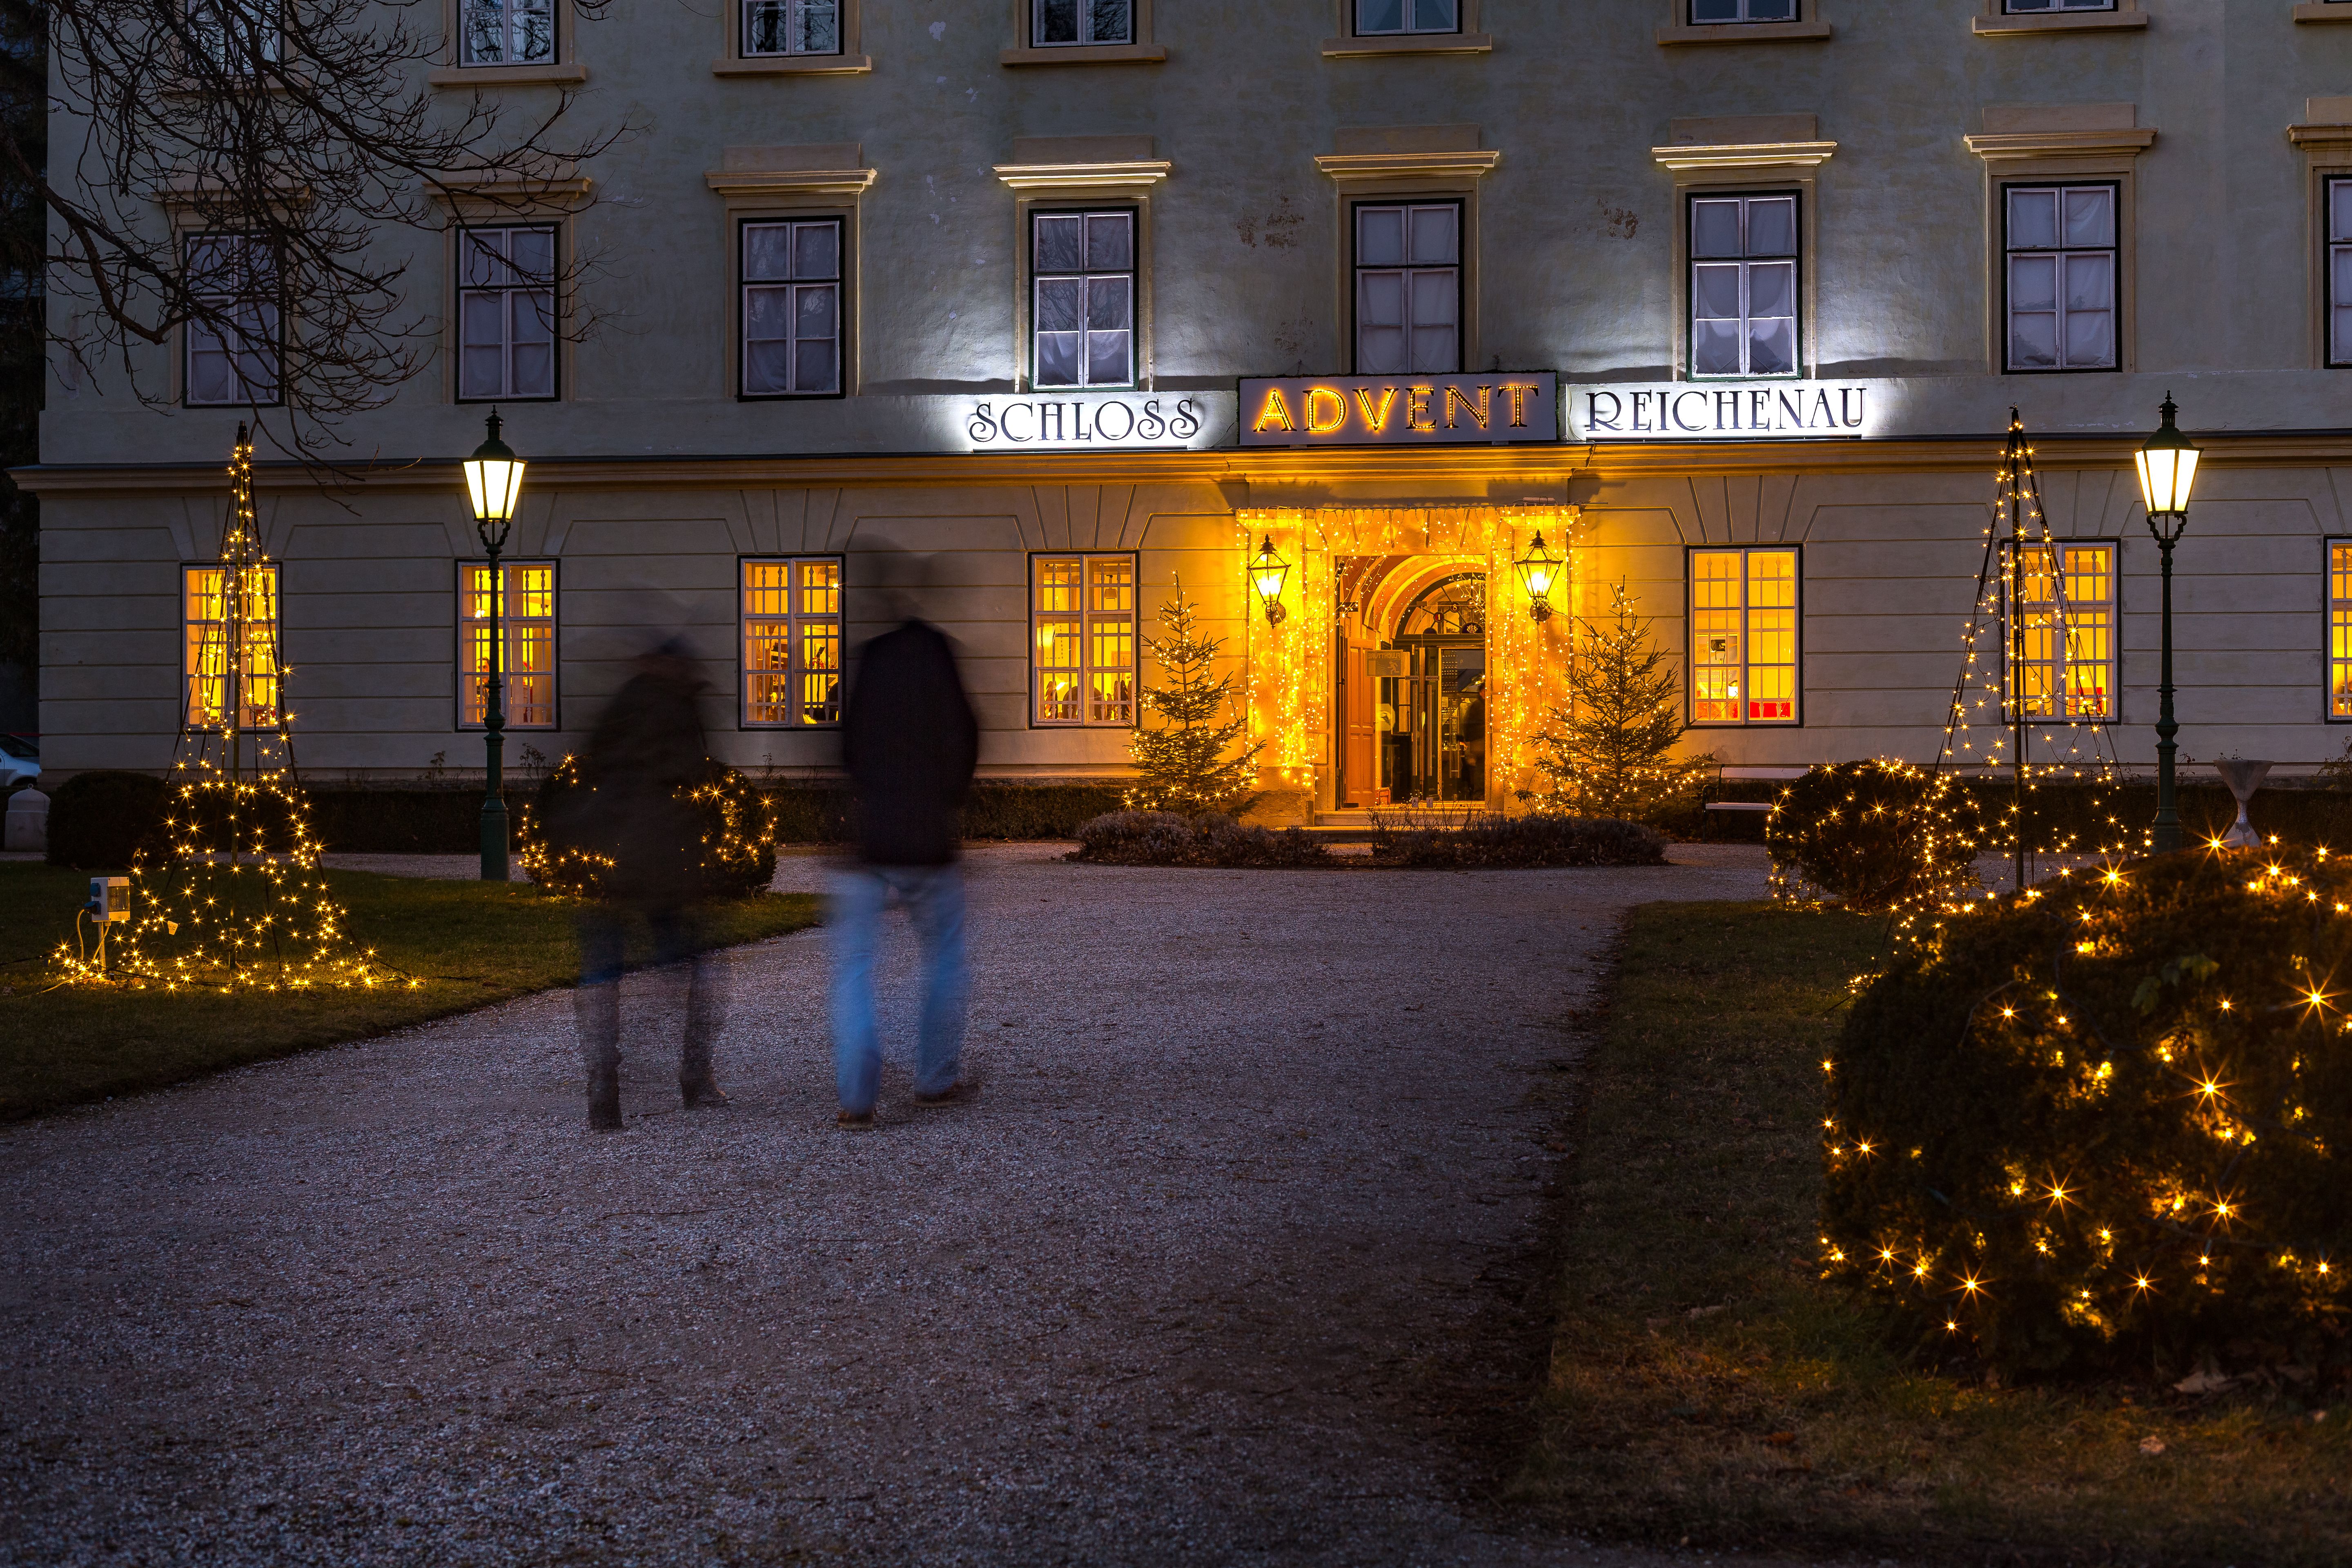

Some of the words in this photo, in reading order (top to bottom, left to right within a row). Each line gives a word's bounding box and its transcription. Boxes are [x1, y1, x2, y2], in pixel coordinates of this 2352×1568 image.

[969, 398, 1199, 443] SCHLOSS
[1253, 385, 1539, 432] ADVENT
[1585, 388, 1867, 433] REICHENAU
